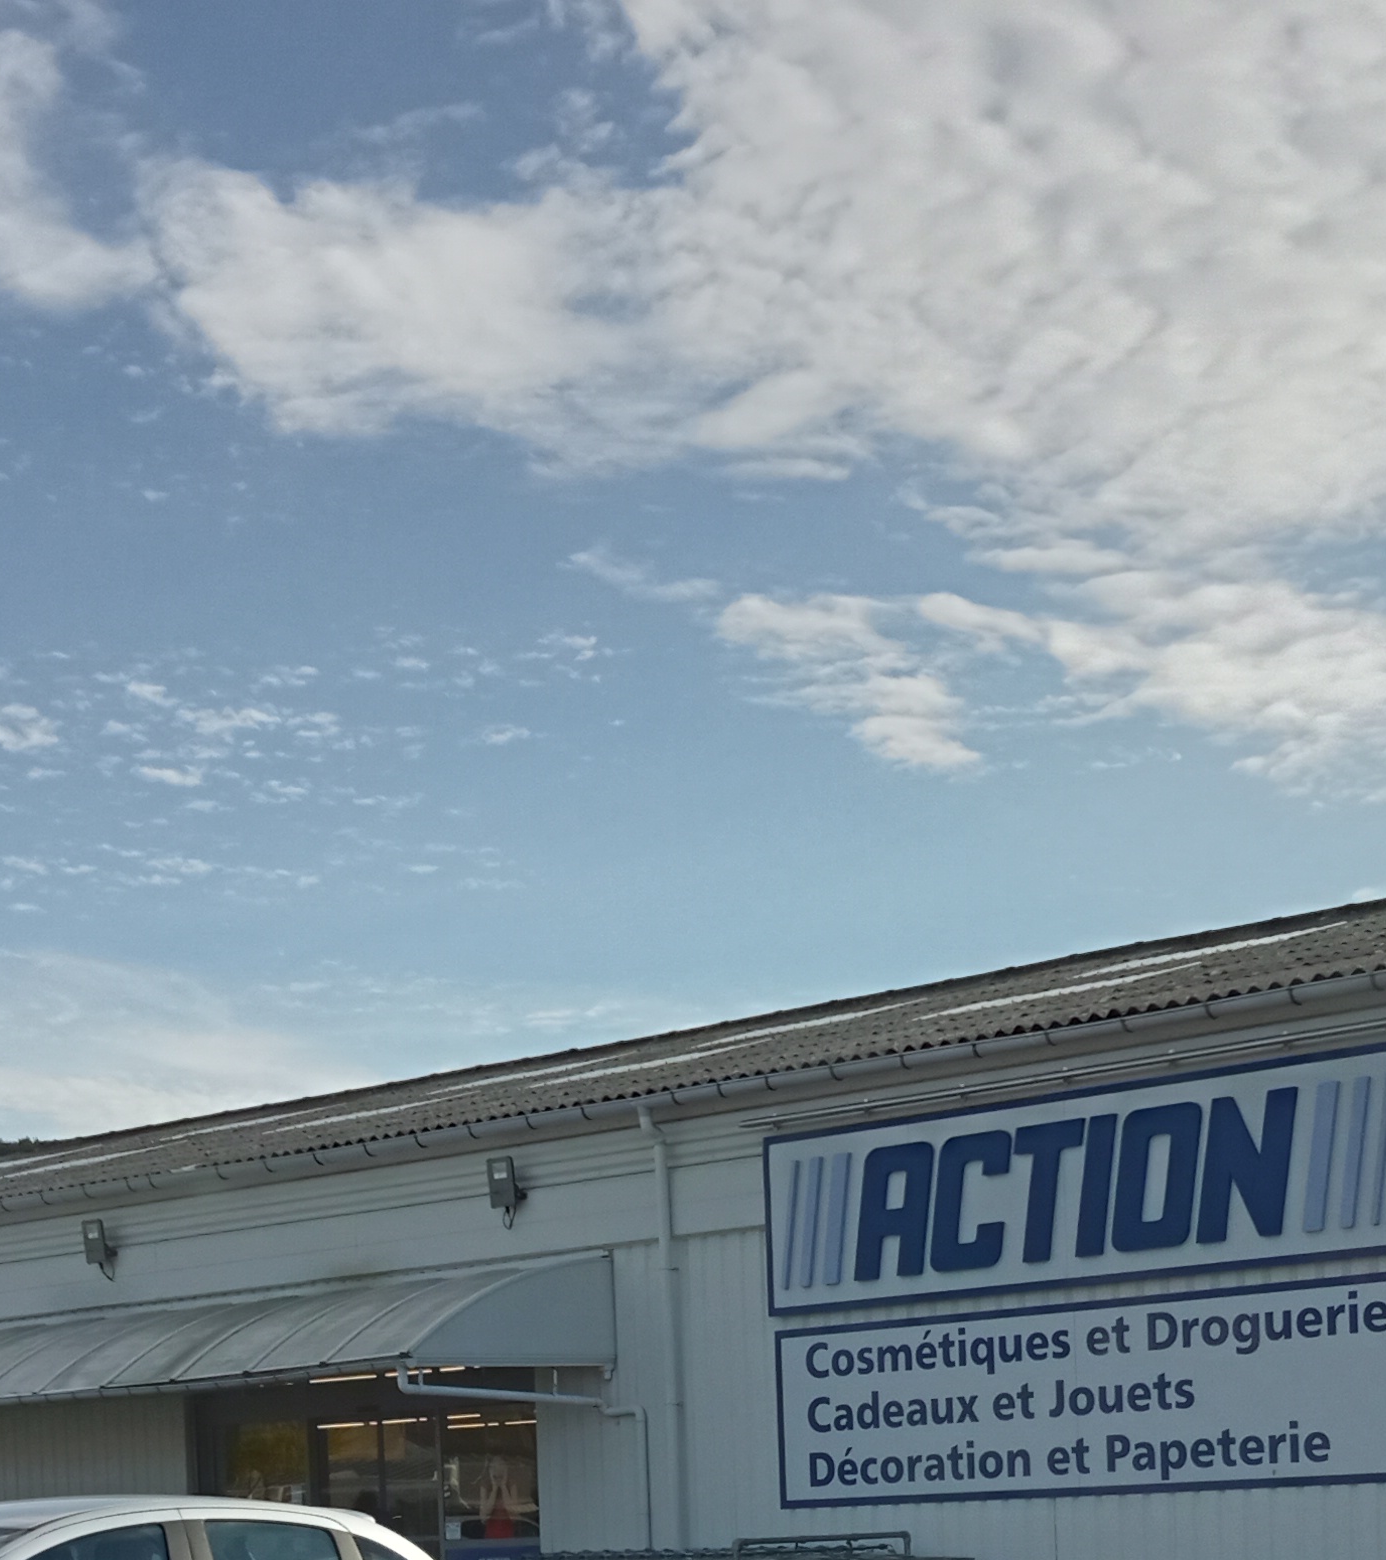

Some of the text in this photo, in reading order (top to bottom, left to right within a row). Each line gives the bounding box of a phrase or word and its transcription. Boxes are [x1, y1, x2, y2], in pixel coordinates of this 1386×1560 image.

[854, 1086, 1298, 1281] ACTION
[805, 1328, 1071, 1379] Cosmétiques
[1086, 1316, 1130, 1356] et
[807, 1372, 1195, 1433] Cadeaux et Jouets
[810, 1420, 1331, 1488] Décoration et Papeterie
